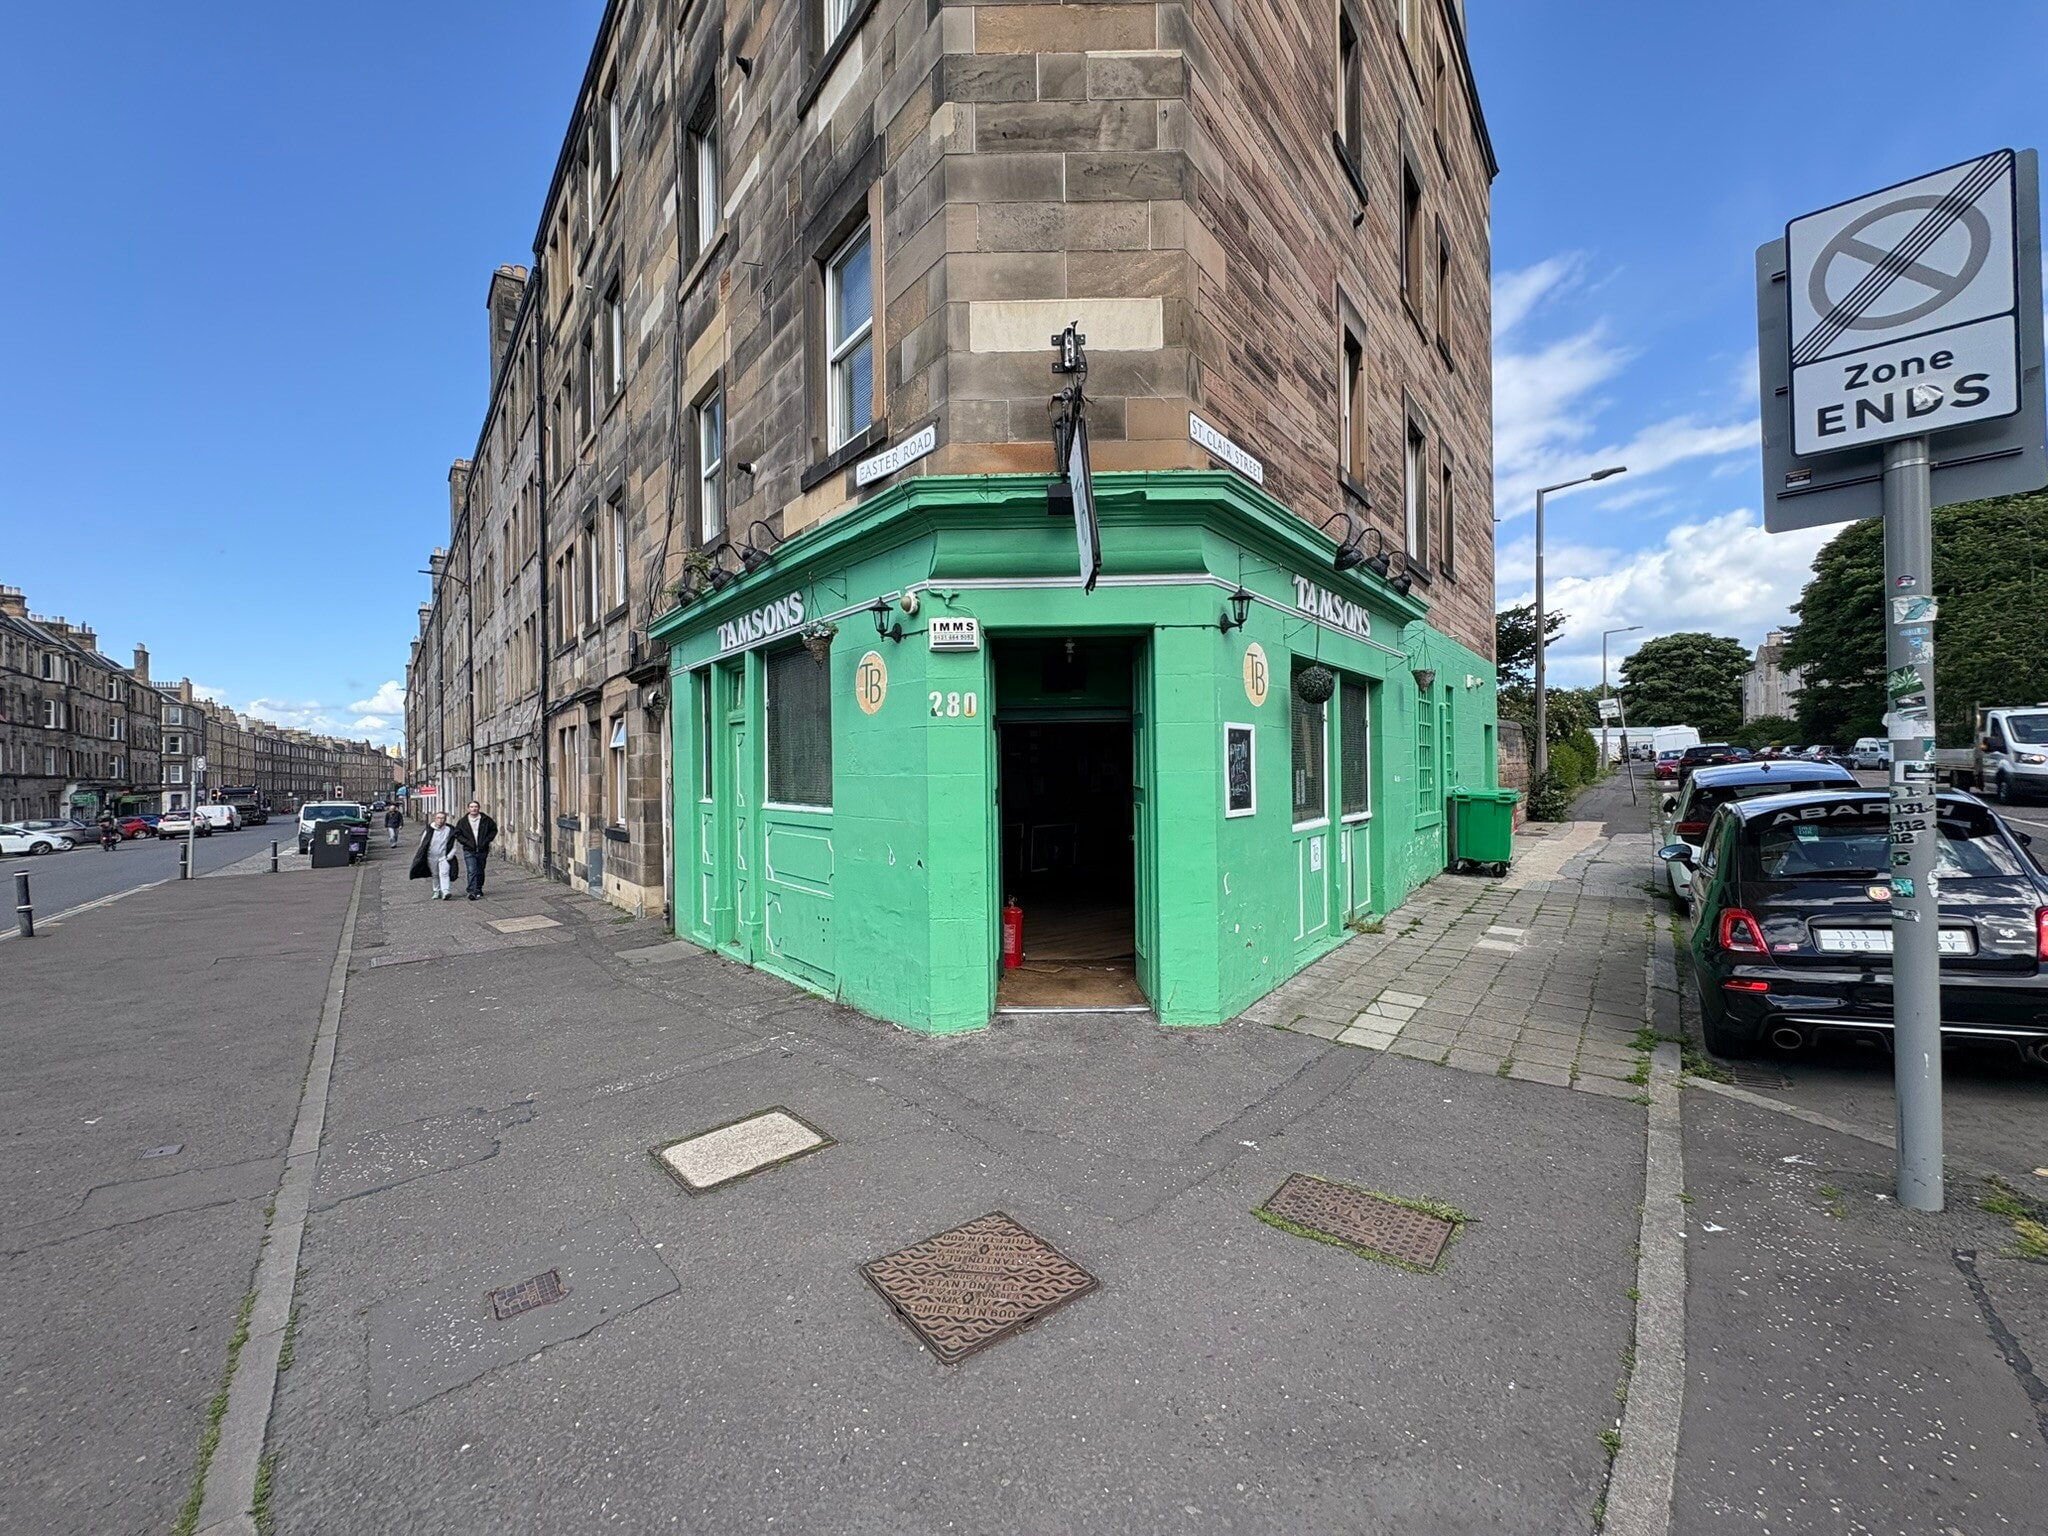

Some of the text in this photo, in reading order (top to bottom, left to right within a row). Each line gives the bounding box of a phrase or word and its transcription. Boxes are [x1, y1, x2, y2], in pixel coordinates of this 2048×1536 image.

[1844, 349, 1954, 391] Zone
[1817, 372, 1991, 438] ENDS
[859, 432, 932, 481] EASTER ROAD
[1192, 419, 1261, 480] ST. CLAIR STREET
[717, 591, 805, 652] TAMSONS
[1292, 574, 1371, 637] TAMSONS
[933, 622, 974, 632] IMMS
[859, 662, 882, 704] TB
[1247, 652, 1265, 696] TB
[928, 690, 977, 718] 280
[1772, 803, 1955, 826] ABARH
[1838, 940, 1871, 949] 666
[927, 1279, 1020, 1292] STANTON PLC
[941, 1296, 991, 1306] MK IV
[914, 1304, 1017, 1319] CHIEFTAIN 600
